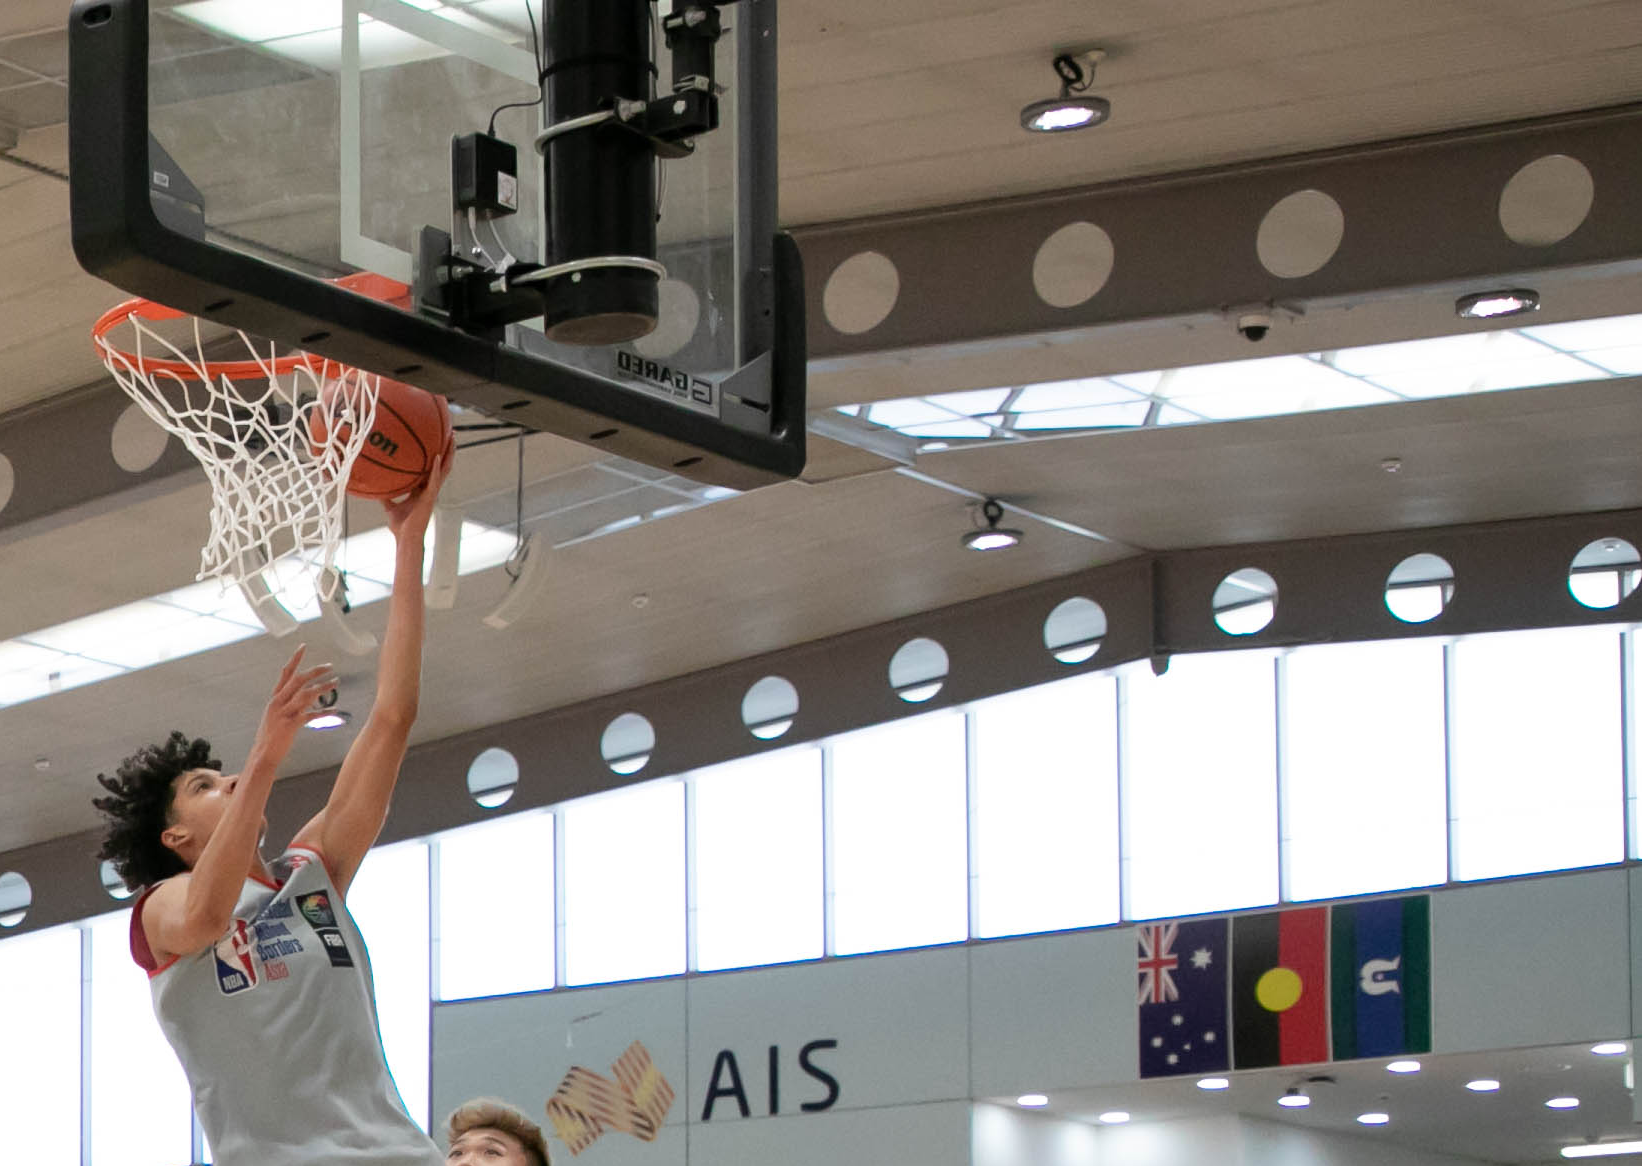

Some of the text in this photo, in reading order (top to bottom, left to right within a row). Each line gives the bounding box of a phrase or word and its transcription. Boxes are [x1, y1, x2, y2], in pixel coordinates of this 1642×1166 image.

[256, 937, 304, 962] Borders
[223, 973, 244, 990] NBA
[264, 961, 289, 981] Asia
[701, 1039, 840, 1122] AIS
